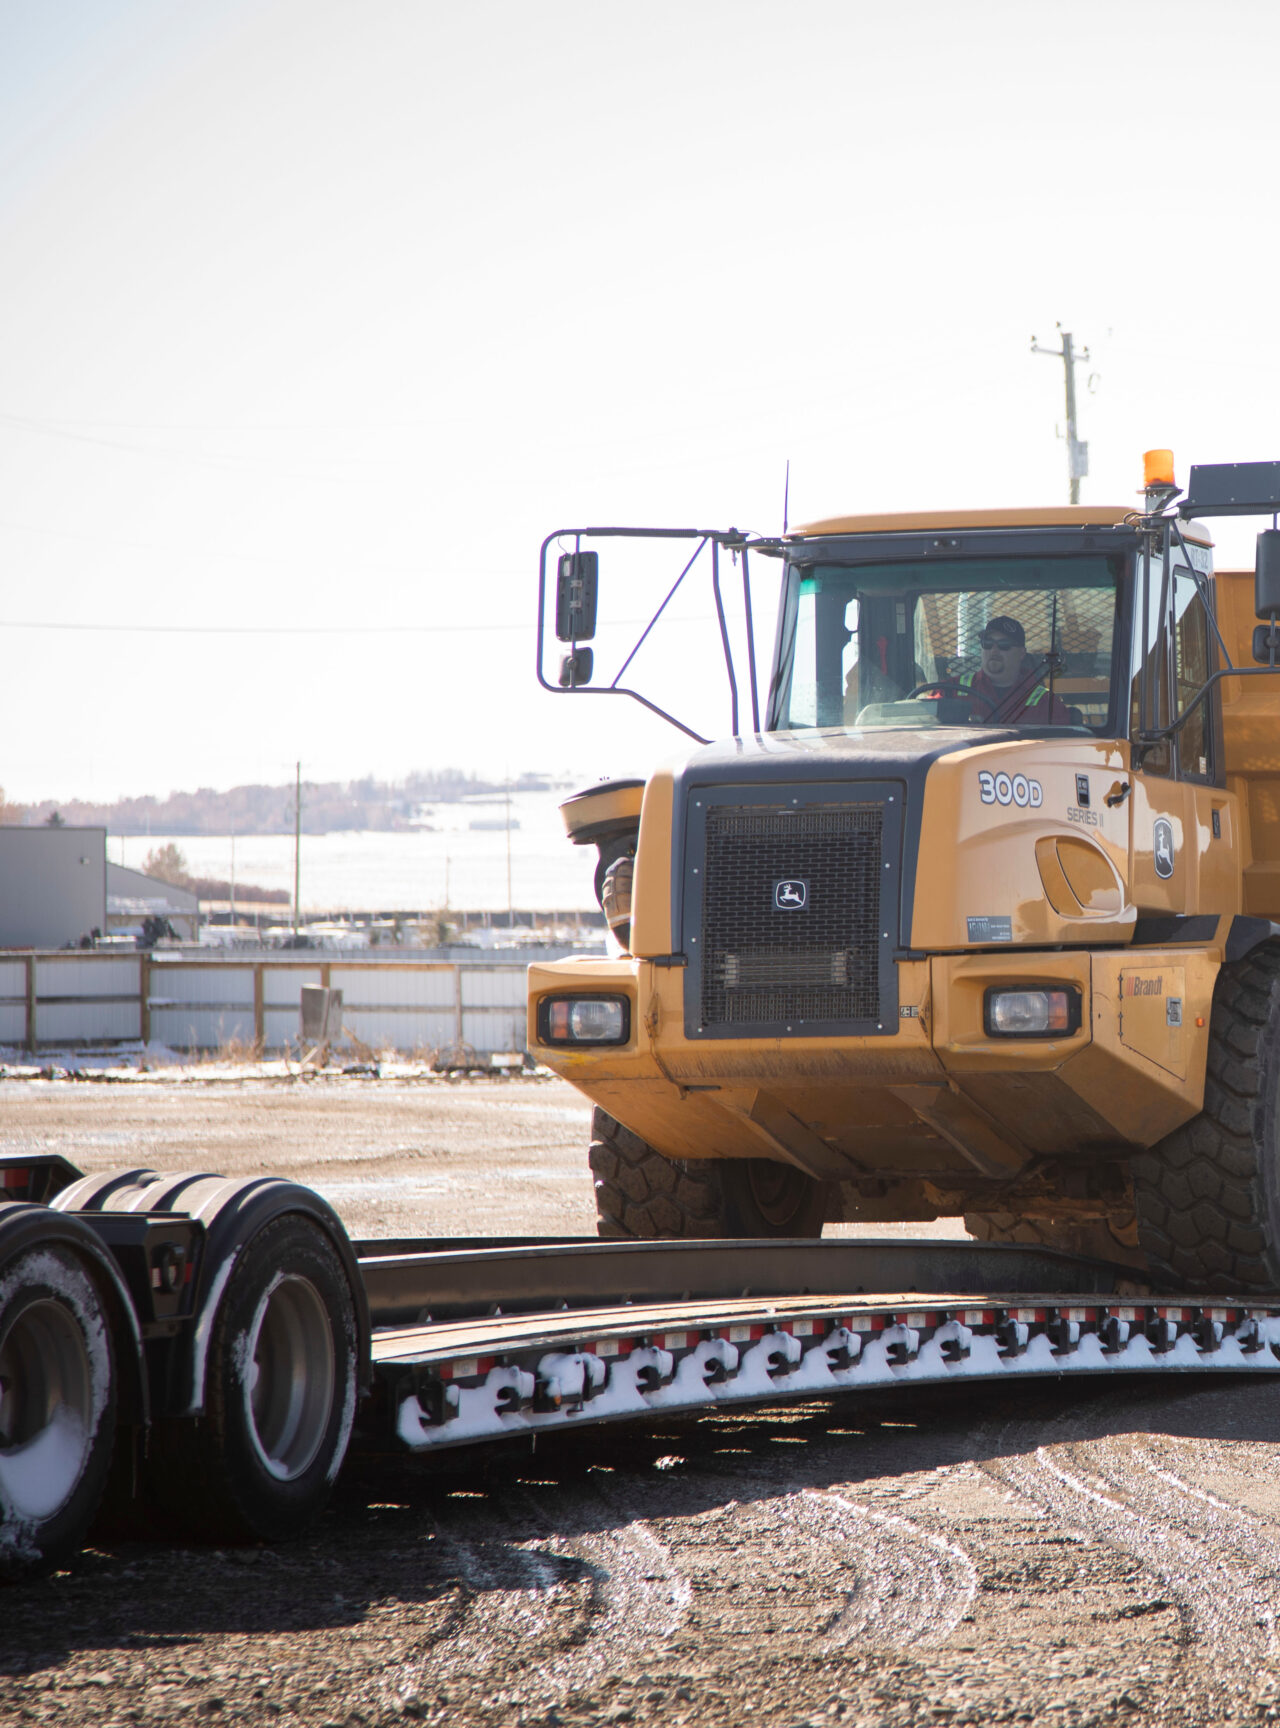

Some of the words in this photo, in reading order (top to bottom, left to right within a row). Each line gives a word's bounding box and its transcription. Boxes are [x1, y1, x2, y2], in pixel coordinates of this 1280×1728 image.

[978, 770, 1043, 809] 300D
[1066, 806, 1098, 827] SERIES
[1133, 975, 1162, 996] Brandt
